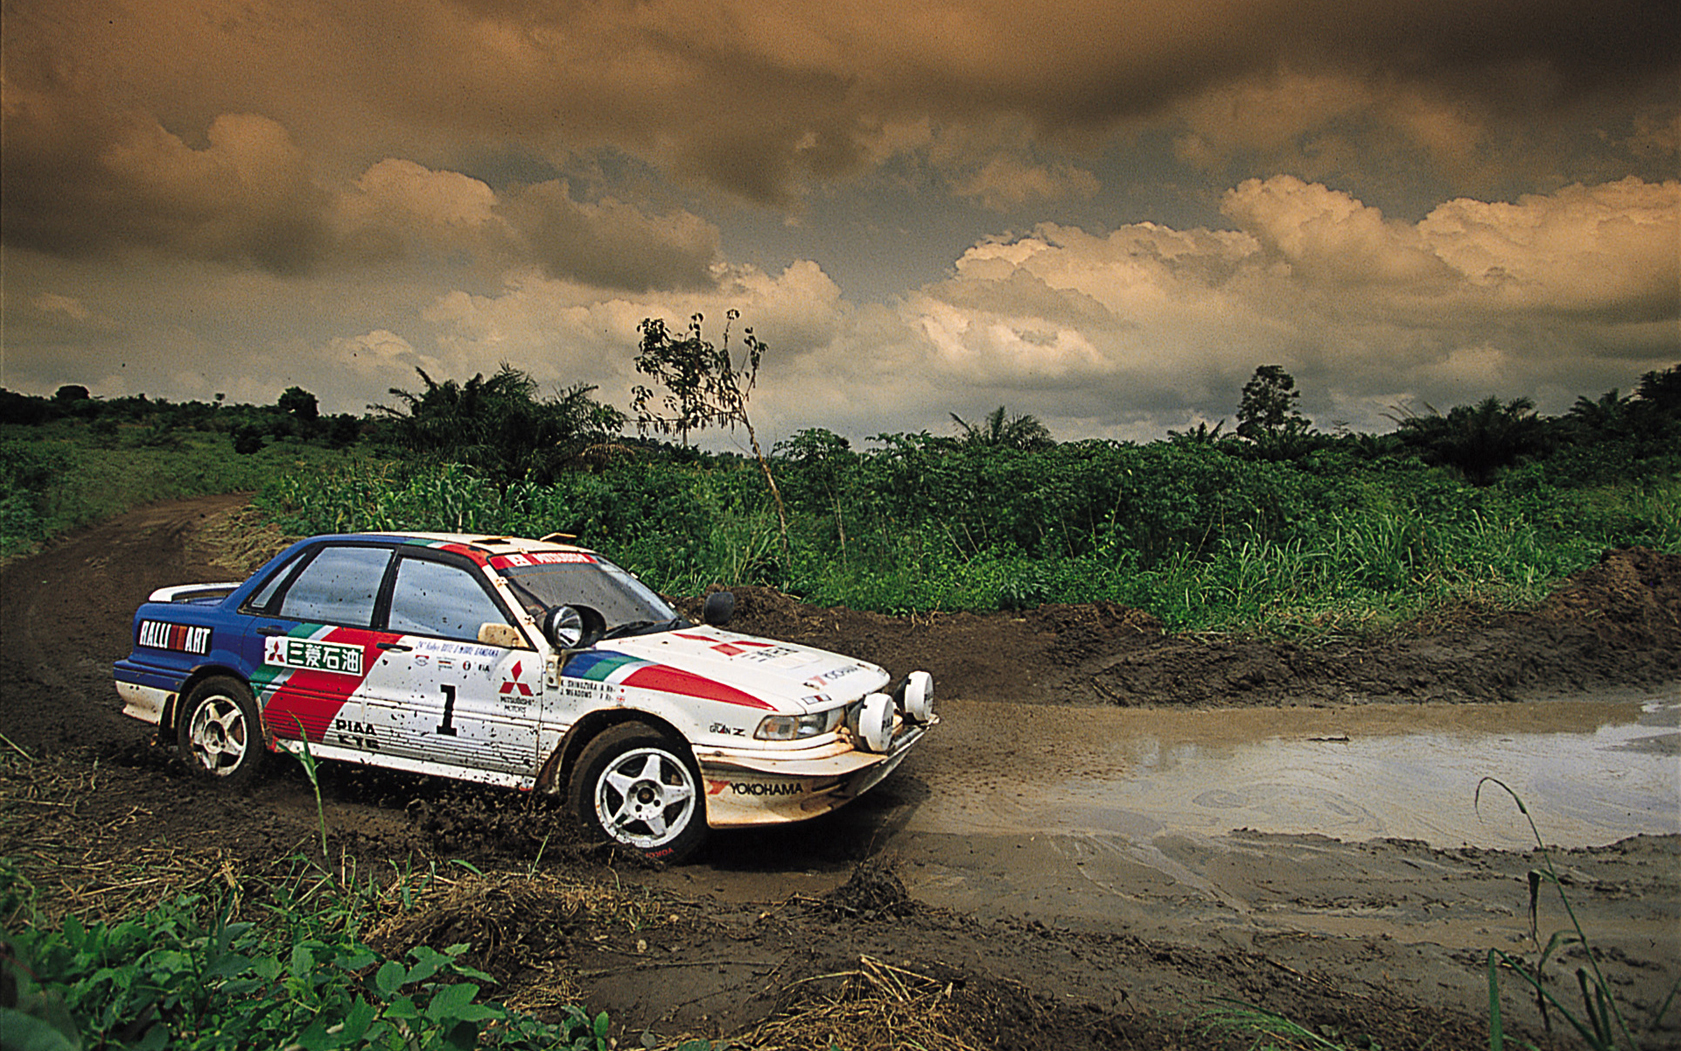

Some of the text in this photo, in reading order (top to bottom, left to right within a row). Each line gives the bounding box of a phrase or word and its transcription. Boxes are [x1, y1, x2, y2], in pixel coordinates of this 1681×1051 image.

[139, 621, 211, 654] RALLI ART
[289, 642, 359, 672] 三菱石油
[500, 696, 533, 706] MITSUBISHI
[504, 704, 528, 714] MOTORS
[436, 684, 457, 737] 1
[335, 719, 377, 736] PIAA
[730, 782, 803, 796] YOKOHAMA
